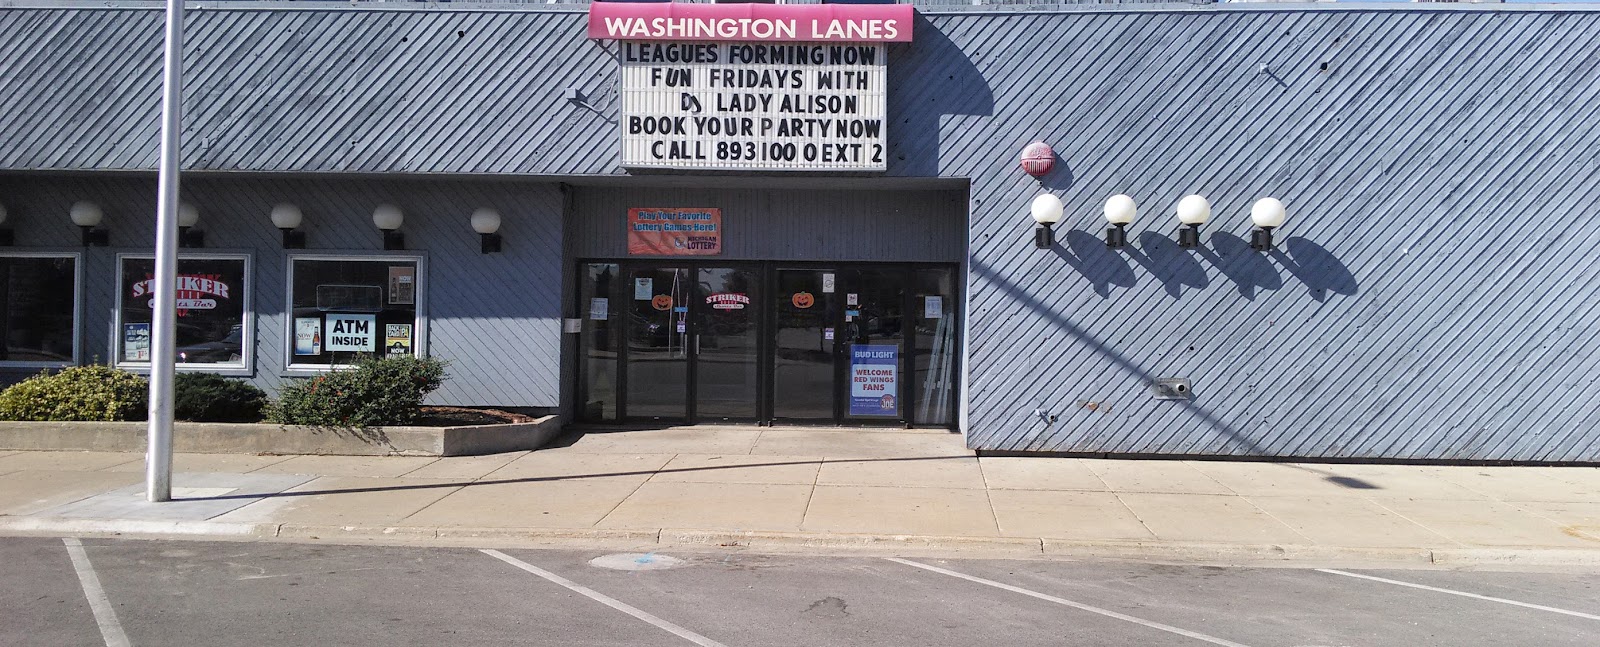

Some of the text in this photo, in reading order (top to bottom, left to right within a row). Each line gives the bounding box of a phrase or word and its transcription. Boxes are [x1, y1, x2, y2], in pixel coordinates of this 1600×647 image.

[605, 17, 898, 39] WASHINGTON LANES
[626, 43, 876, 66] LEAGUES FORMING NOW
[652, 68, 868, 90] FUN FRIDAYS WITH
[717, 93, 773, 113] LADY
[779, 95, 857, 114] ALISON
[630, 117, 686, 135] BOOK
[695, 117, 753, 136] YOUR
[837, 120, 881, 138] NOW
[652, 141, 706, 160] CALL
[872, 143, 883, 163] 2
[638, 211, 712, 220] Play Your Favorite
[633, 222, 717, 232] Lottery Games Here!
[133, 276, 230, 299] STIKER
[706, 294, 750, 304] STRIKER
[333, 319, 369, 334] ATM
[332, 336, 369, 346] INSIDE
[871, 351, 894, 359] LIGHT
